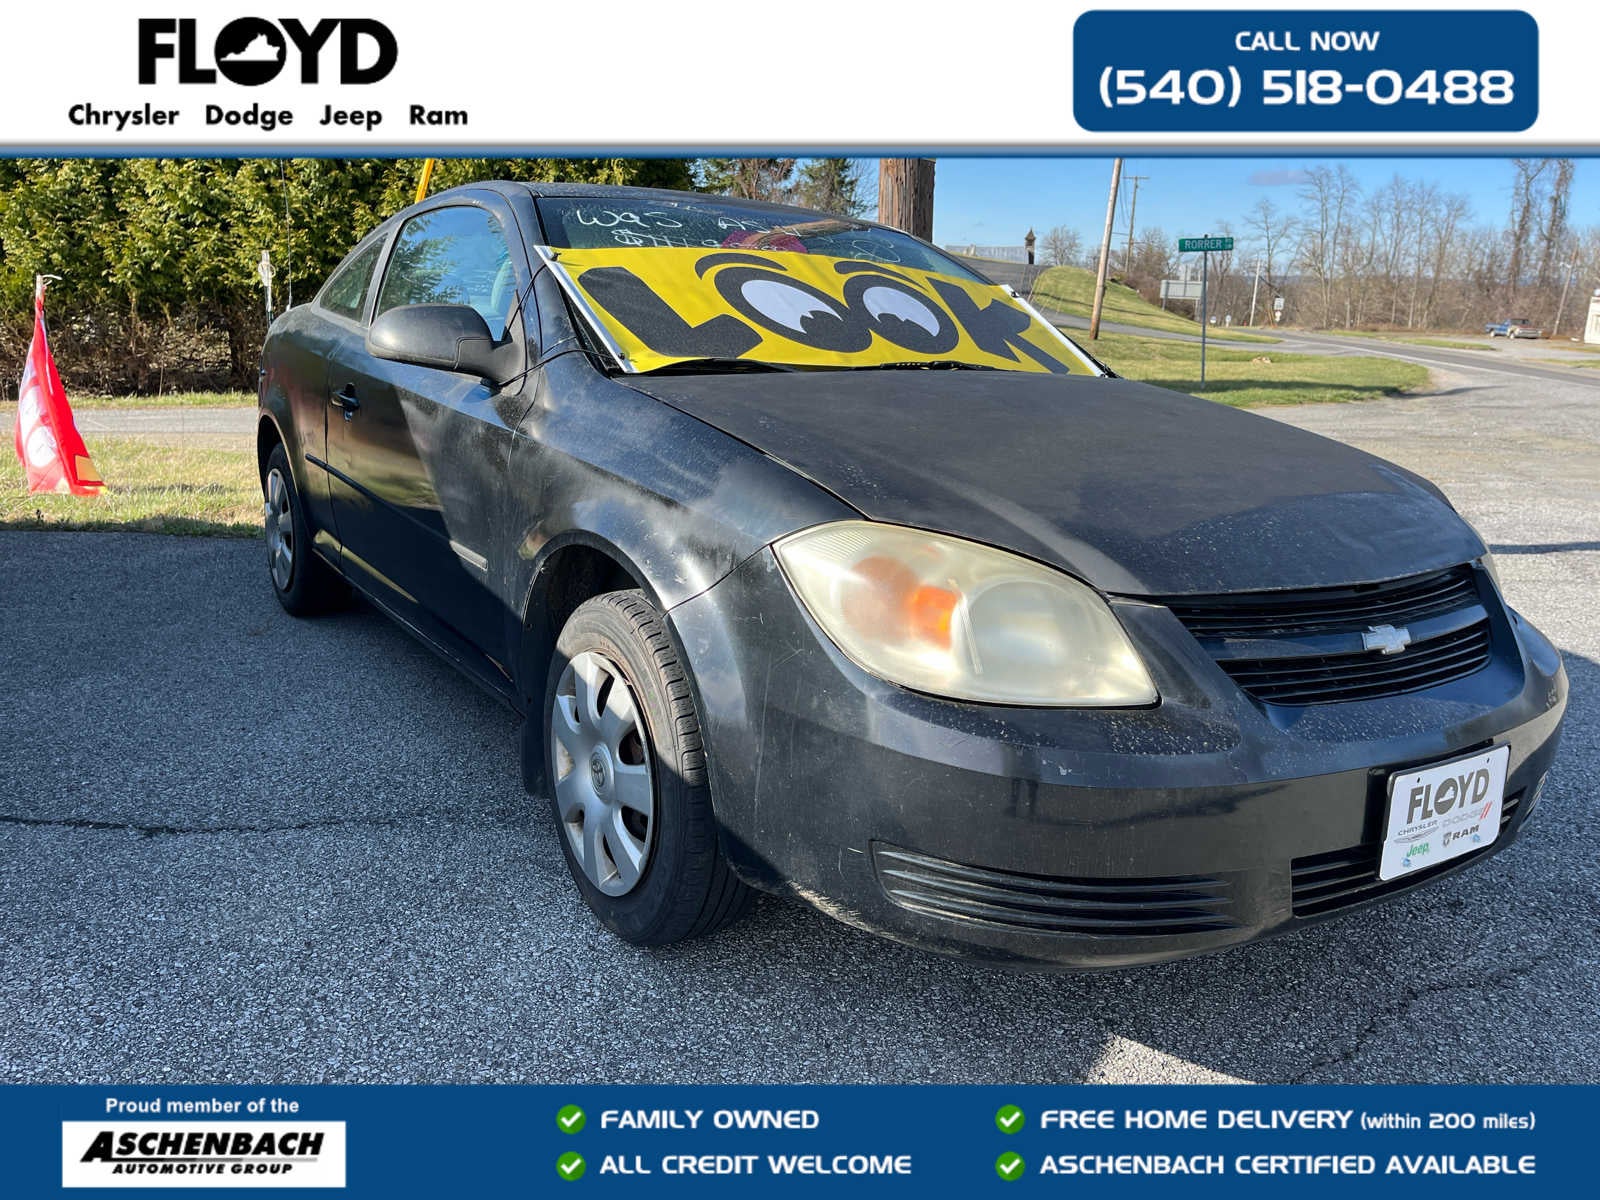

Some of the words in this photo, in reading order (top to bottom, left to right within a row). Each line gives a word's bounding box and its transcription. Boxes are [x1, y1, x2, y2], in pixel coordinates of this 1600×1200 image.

[1184, 239, 1222, 249] RORRER
[1406, 768, 1490, 825] FLOYD
[1397, 819, 1439, 837] CHRYSLER
[1452, 825, 1480, 841] RAM
[1406, 842, 1430, 858] Jeep
